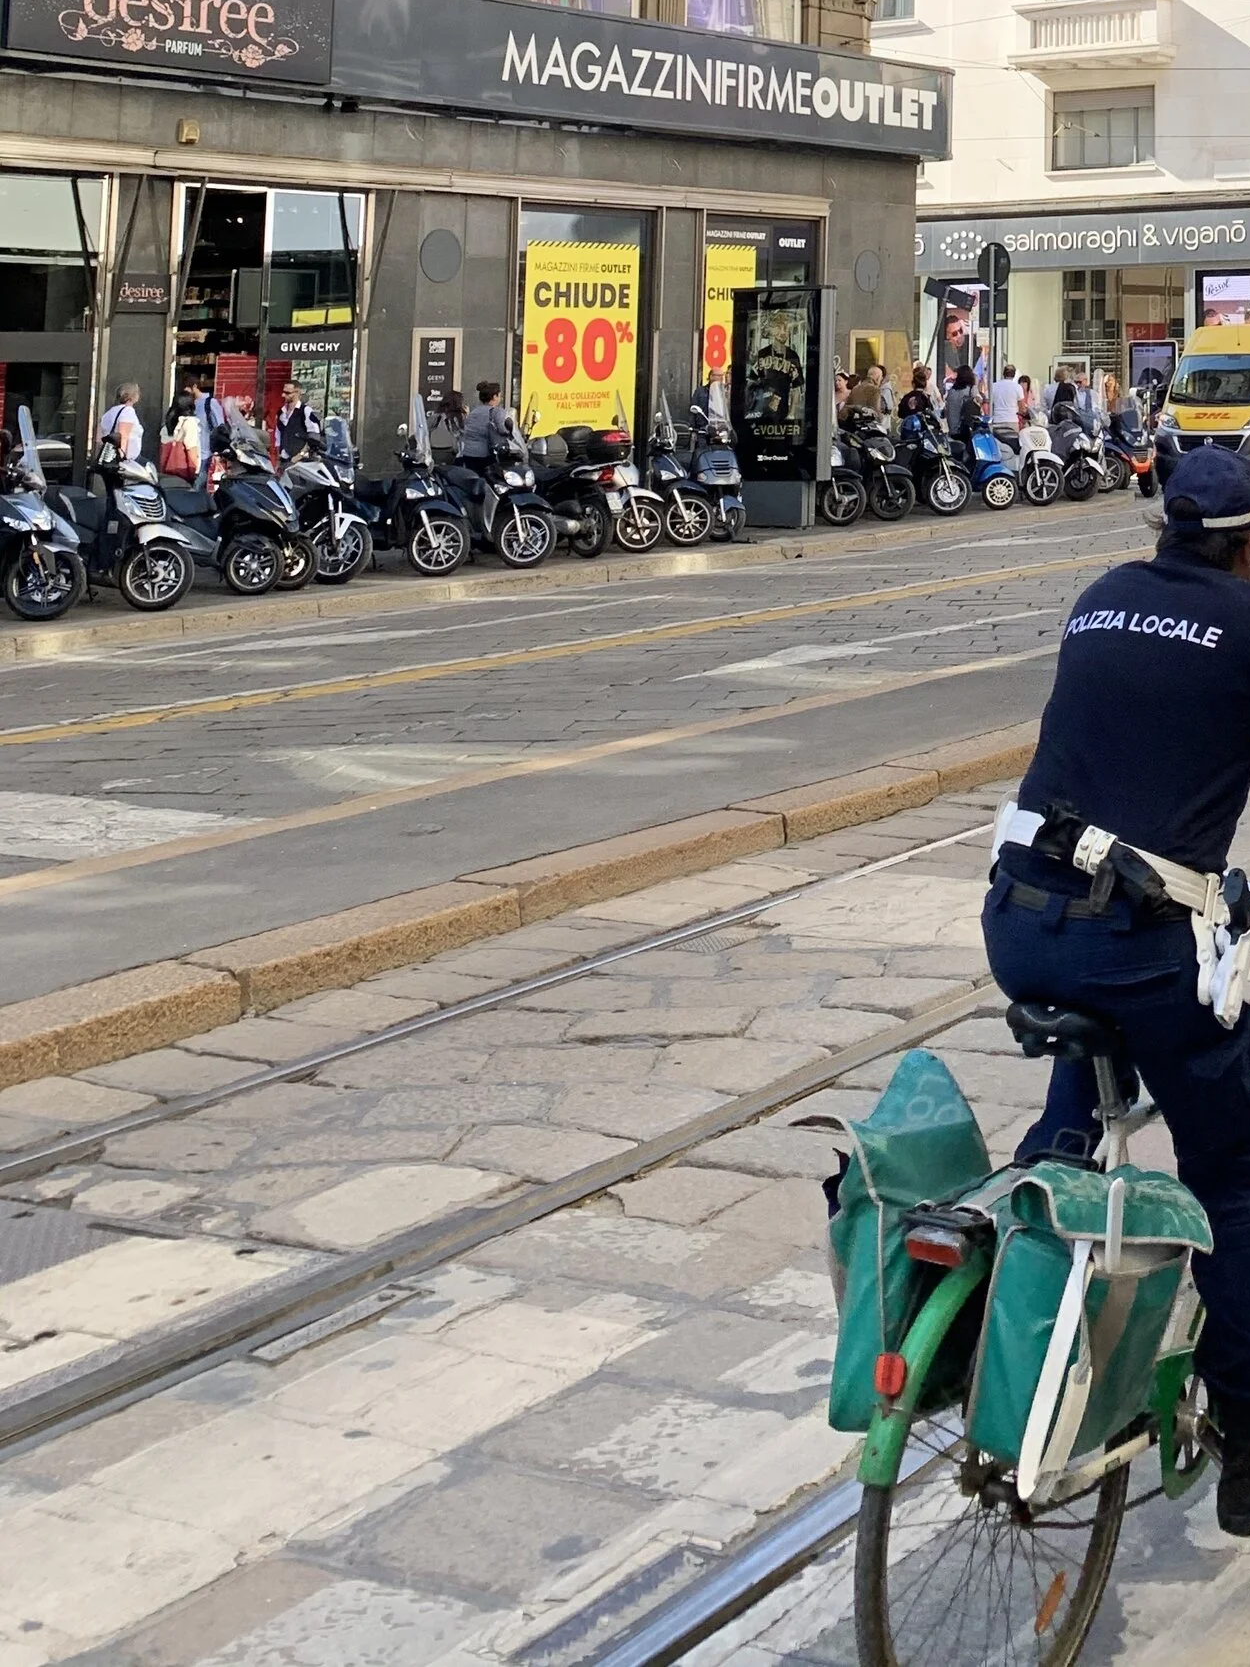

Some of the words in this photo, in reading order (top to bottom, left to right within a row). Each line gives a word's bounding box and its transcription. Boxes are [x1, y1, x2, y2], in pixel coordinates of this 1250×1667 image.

[165, 39, 203, 56] PARFUM
[746, 232, 766, 240] OUTLET
[1003, 226, 1137, 254] salmoiraghi
[1143, 223, 1160, 246] &
[778, 237, 806, 249] OUTLET
[534, 262, 578, 272] MAGAZZINI
[580, 263, 600, 273] FIRME
[600, 264, 632, 274] OUTLET
[533, 281, 631, 309] CHIUDE
[280, 342, 340, 352] GIVENCHY
[548, 392, 568, 401] SULLA
[571, 391, 610, 400] COLLEZIONE
[1194, 412, 1231, 420] DHL
[1064, 610, 1126, 640] POLIZIA
[1128, 613, 1223, 649] LOCALE
